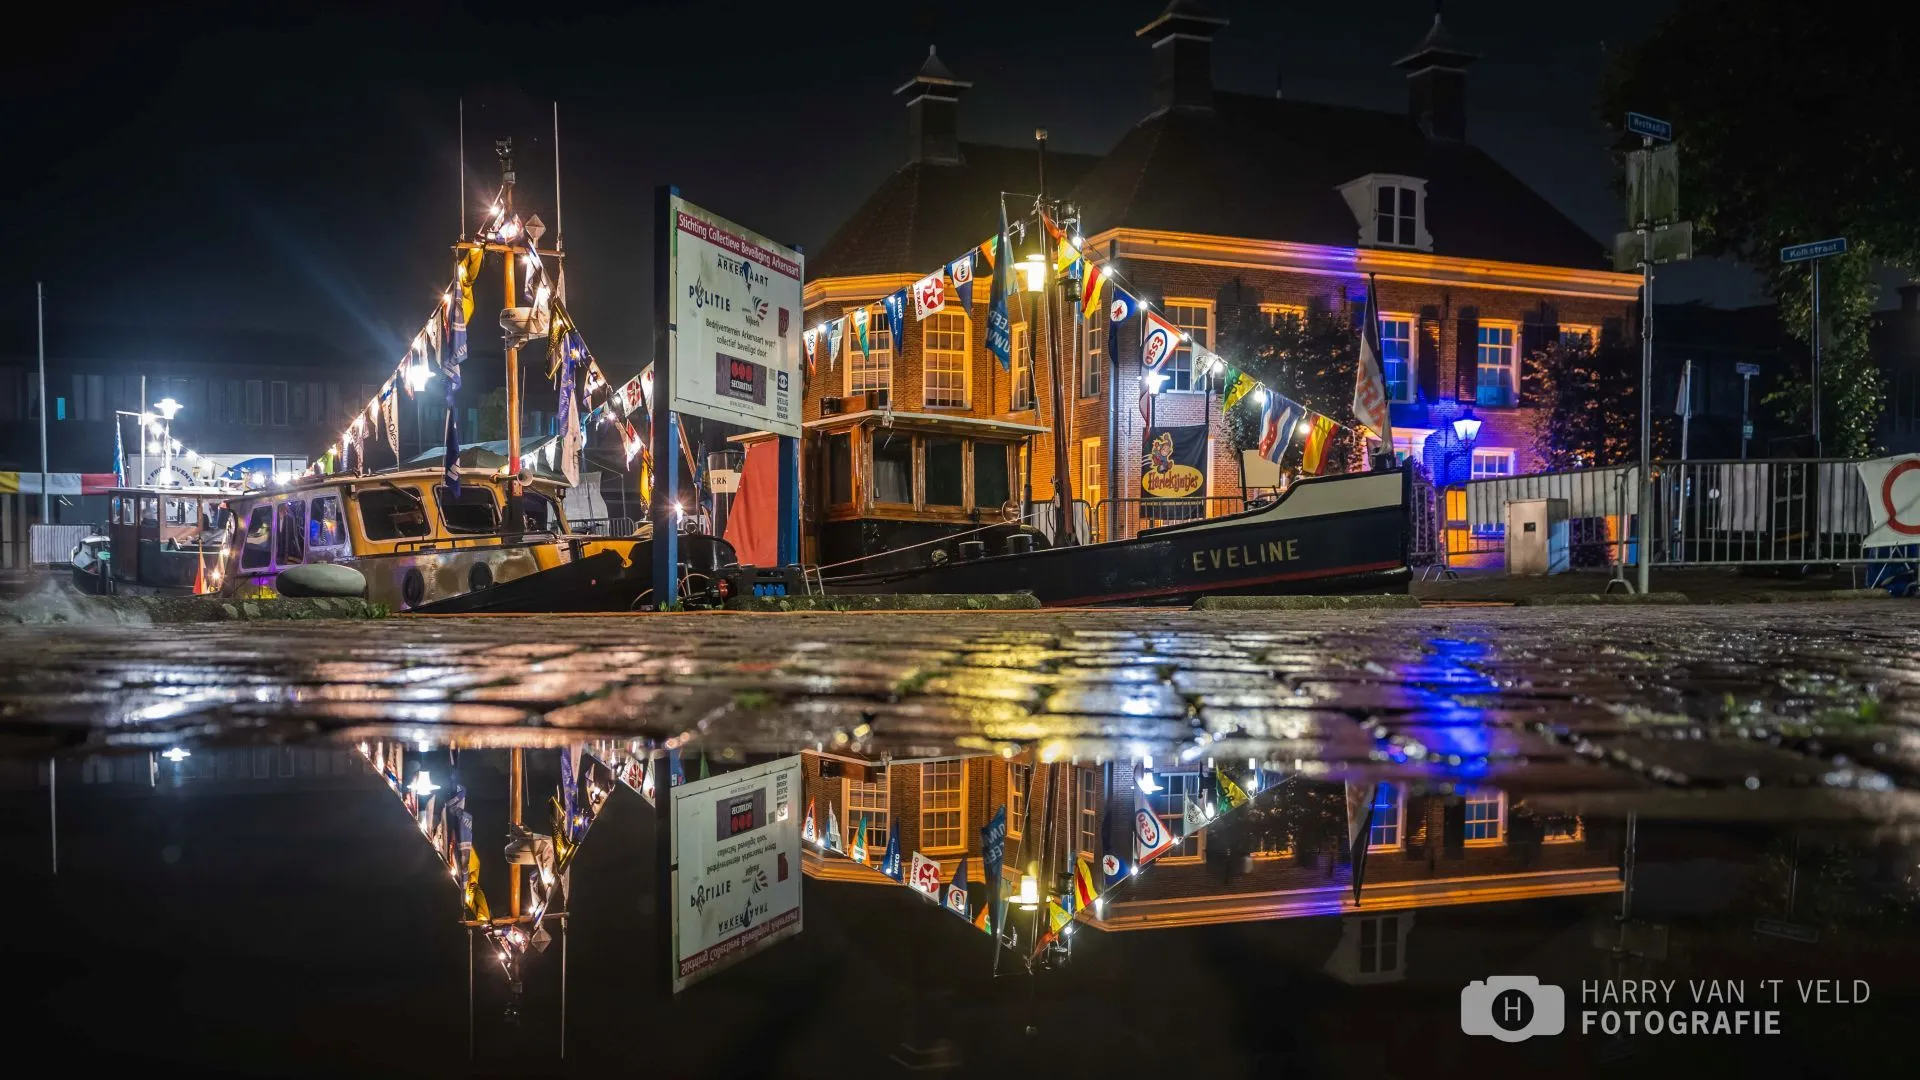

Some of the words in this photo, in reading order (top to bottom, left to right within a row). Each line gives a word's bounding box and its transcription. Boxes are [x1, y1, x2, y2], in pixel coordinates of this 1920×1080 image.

[679, 214, 707, 239] Stichting
[708, 228, 740, 251] Collectieve
[741, 241, 771, 266] Beveiliging
[771, 255, 799, 277] Arkervaart
[689, 285, 731, 312] POLITIE
[915, 285, 923, 316] TEXACO
[745, 315, 760, 328] Nijkerk
[1192, 539, 1300, 572] EVELINE
